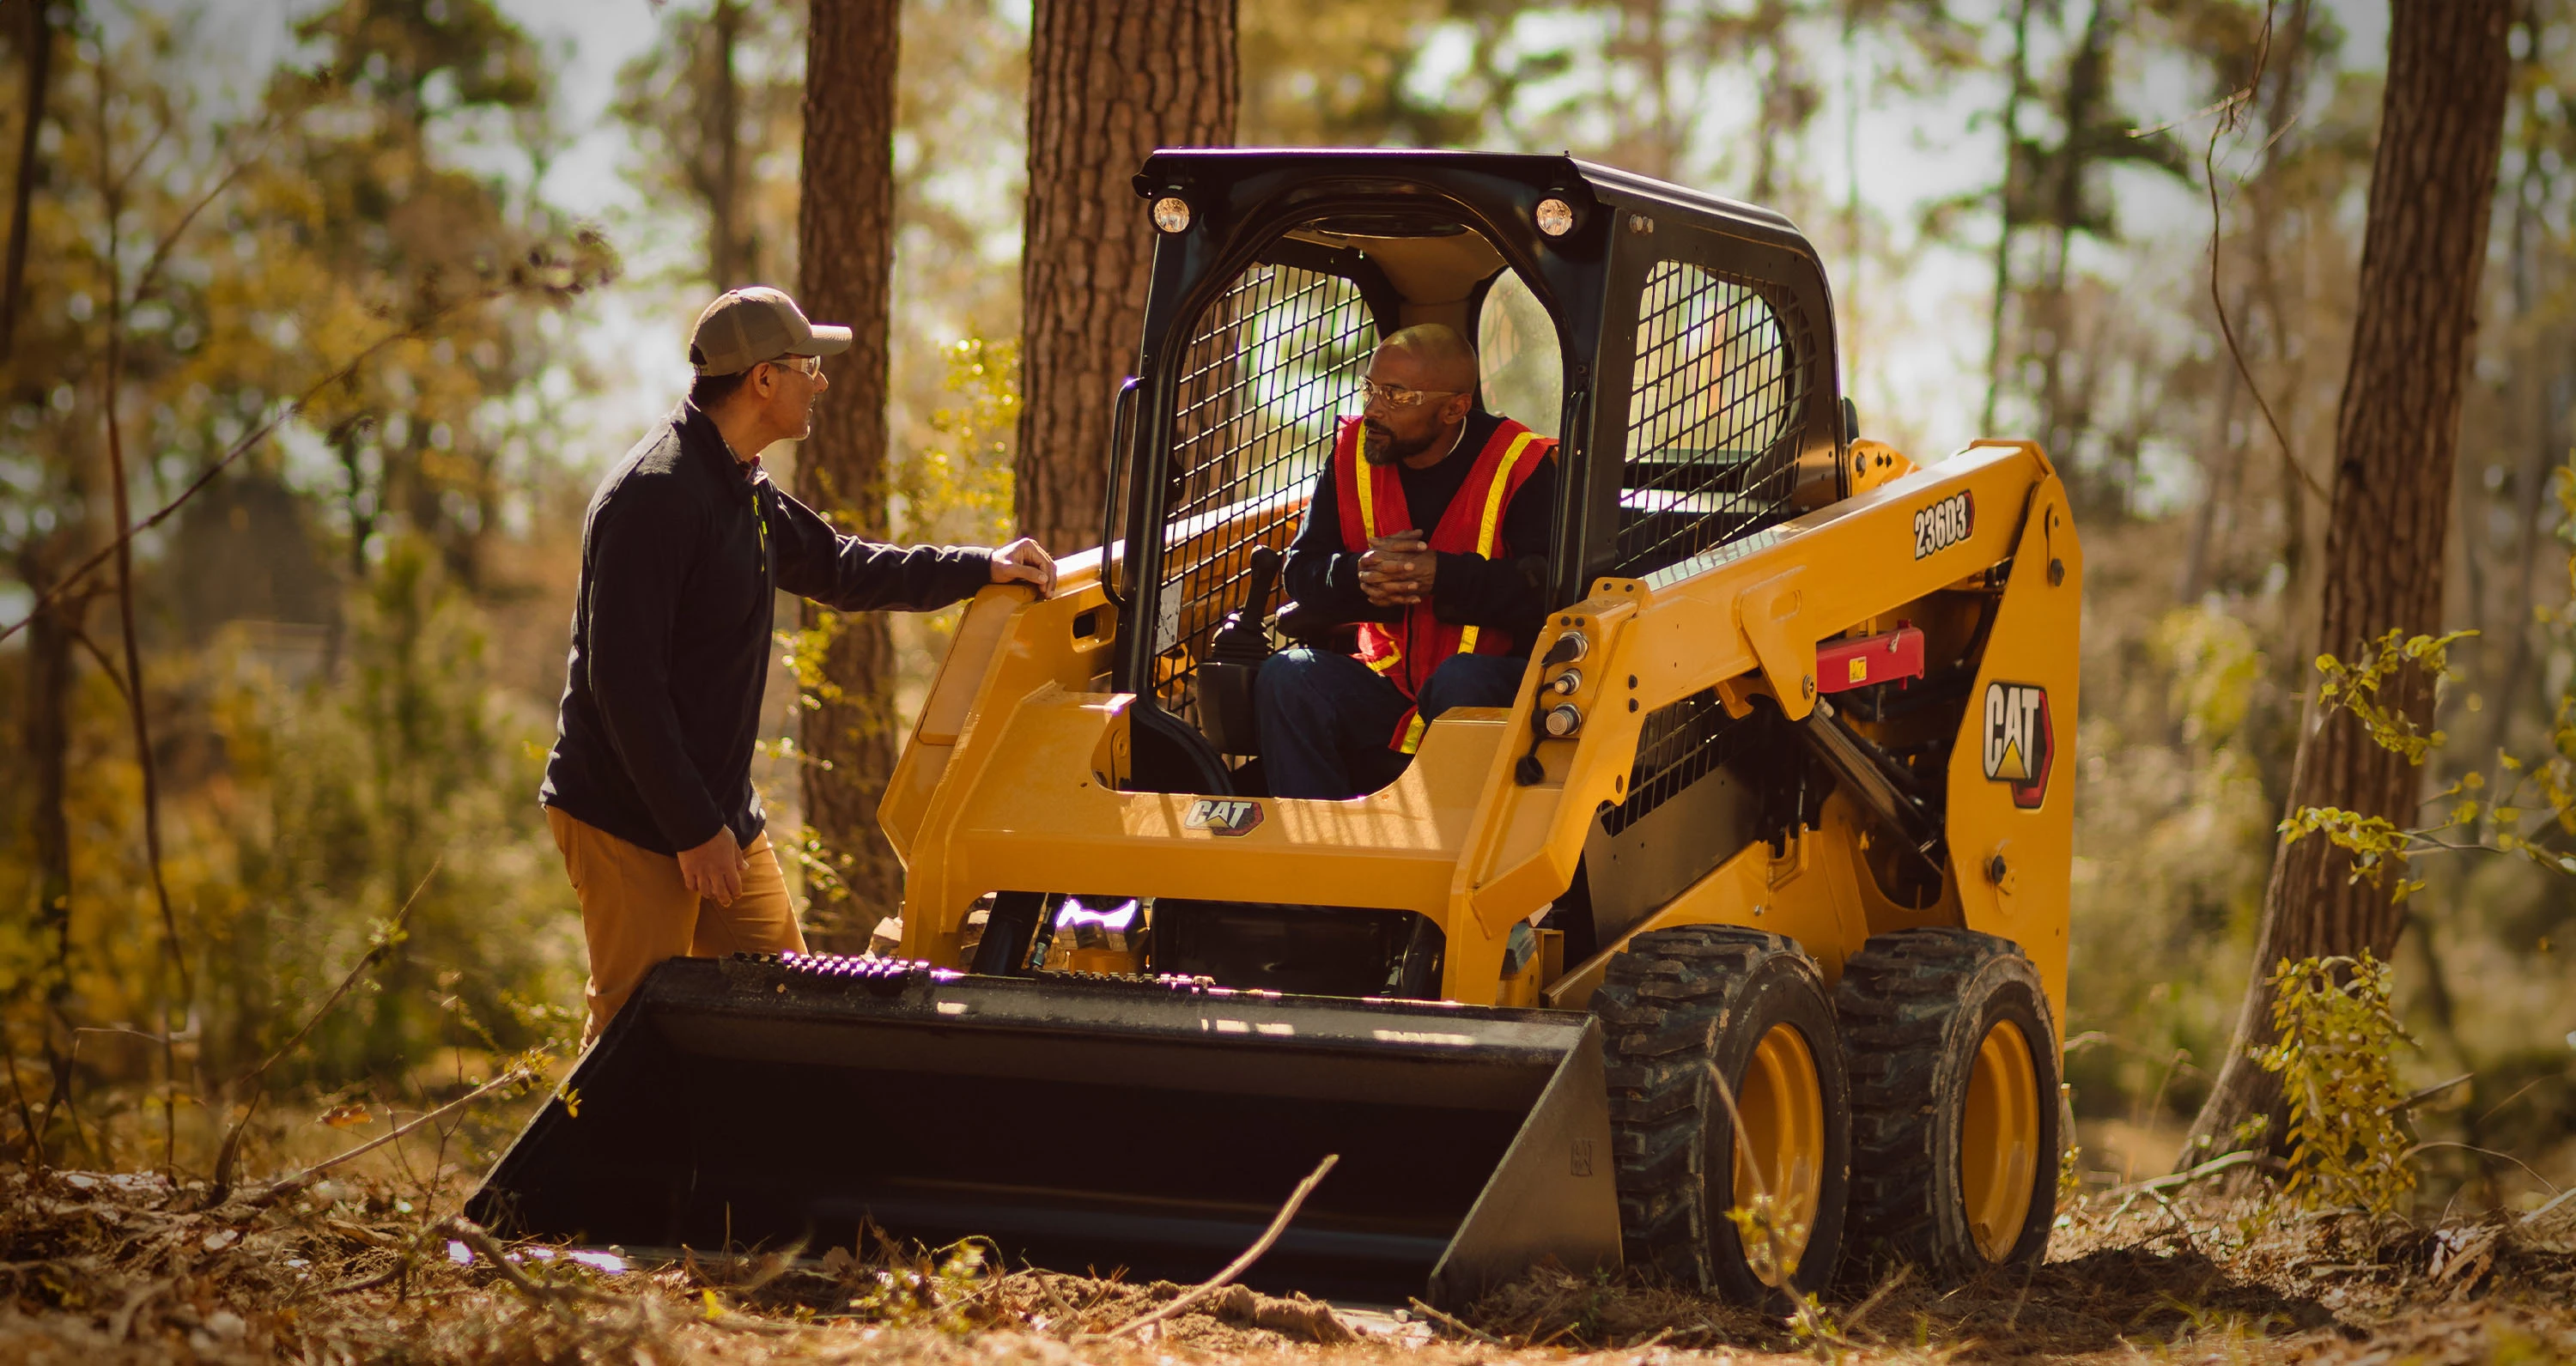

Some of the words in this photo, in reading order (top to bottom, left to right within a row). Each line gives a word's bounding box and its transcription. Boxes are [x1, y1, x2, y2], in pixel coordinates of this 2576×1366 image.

[1915, 494, 1967, 558] 236D3
[1985, 683, 2039, 780] CAT
[1186, 800, 1252, 829] CAT
